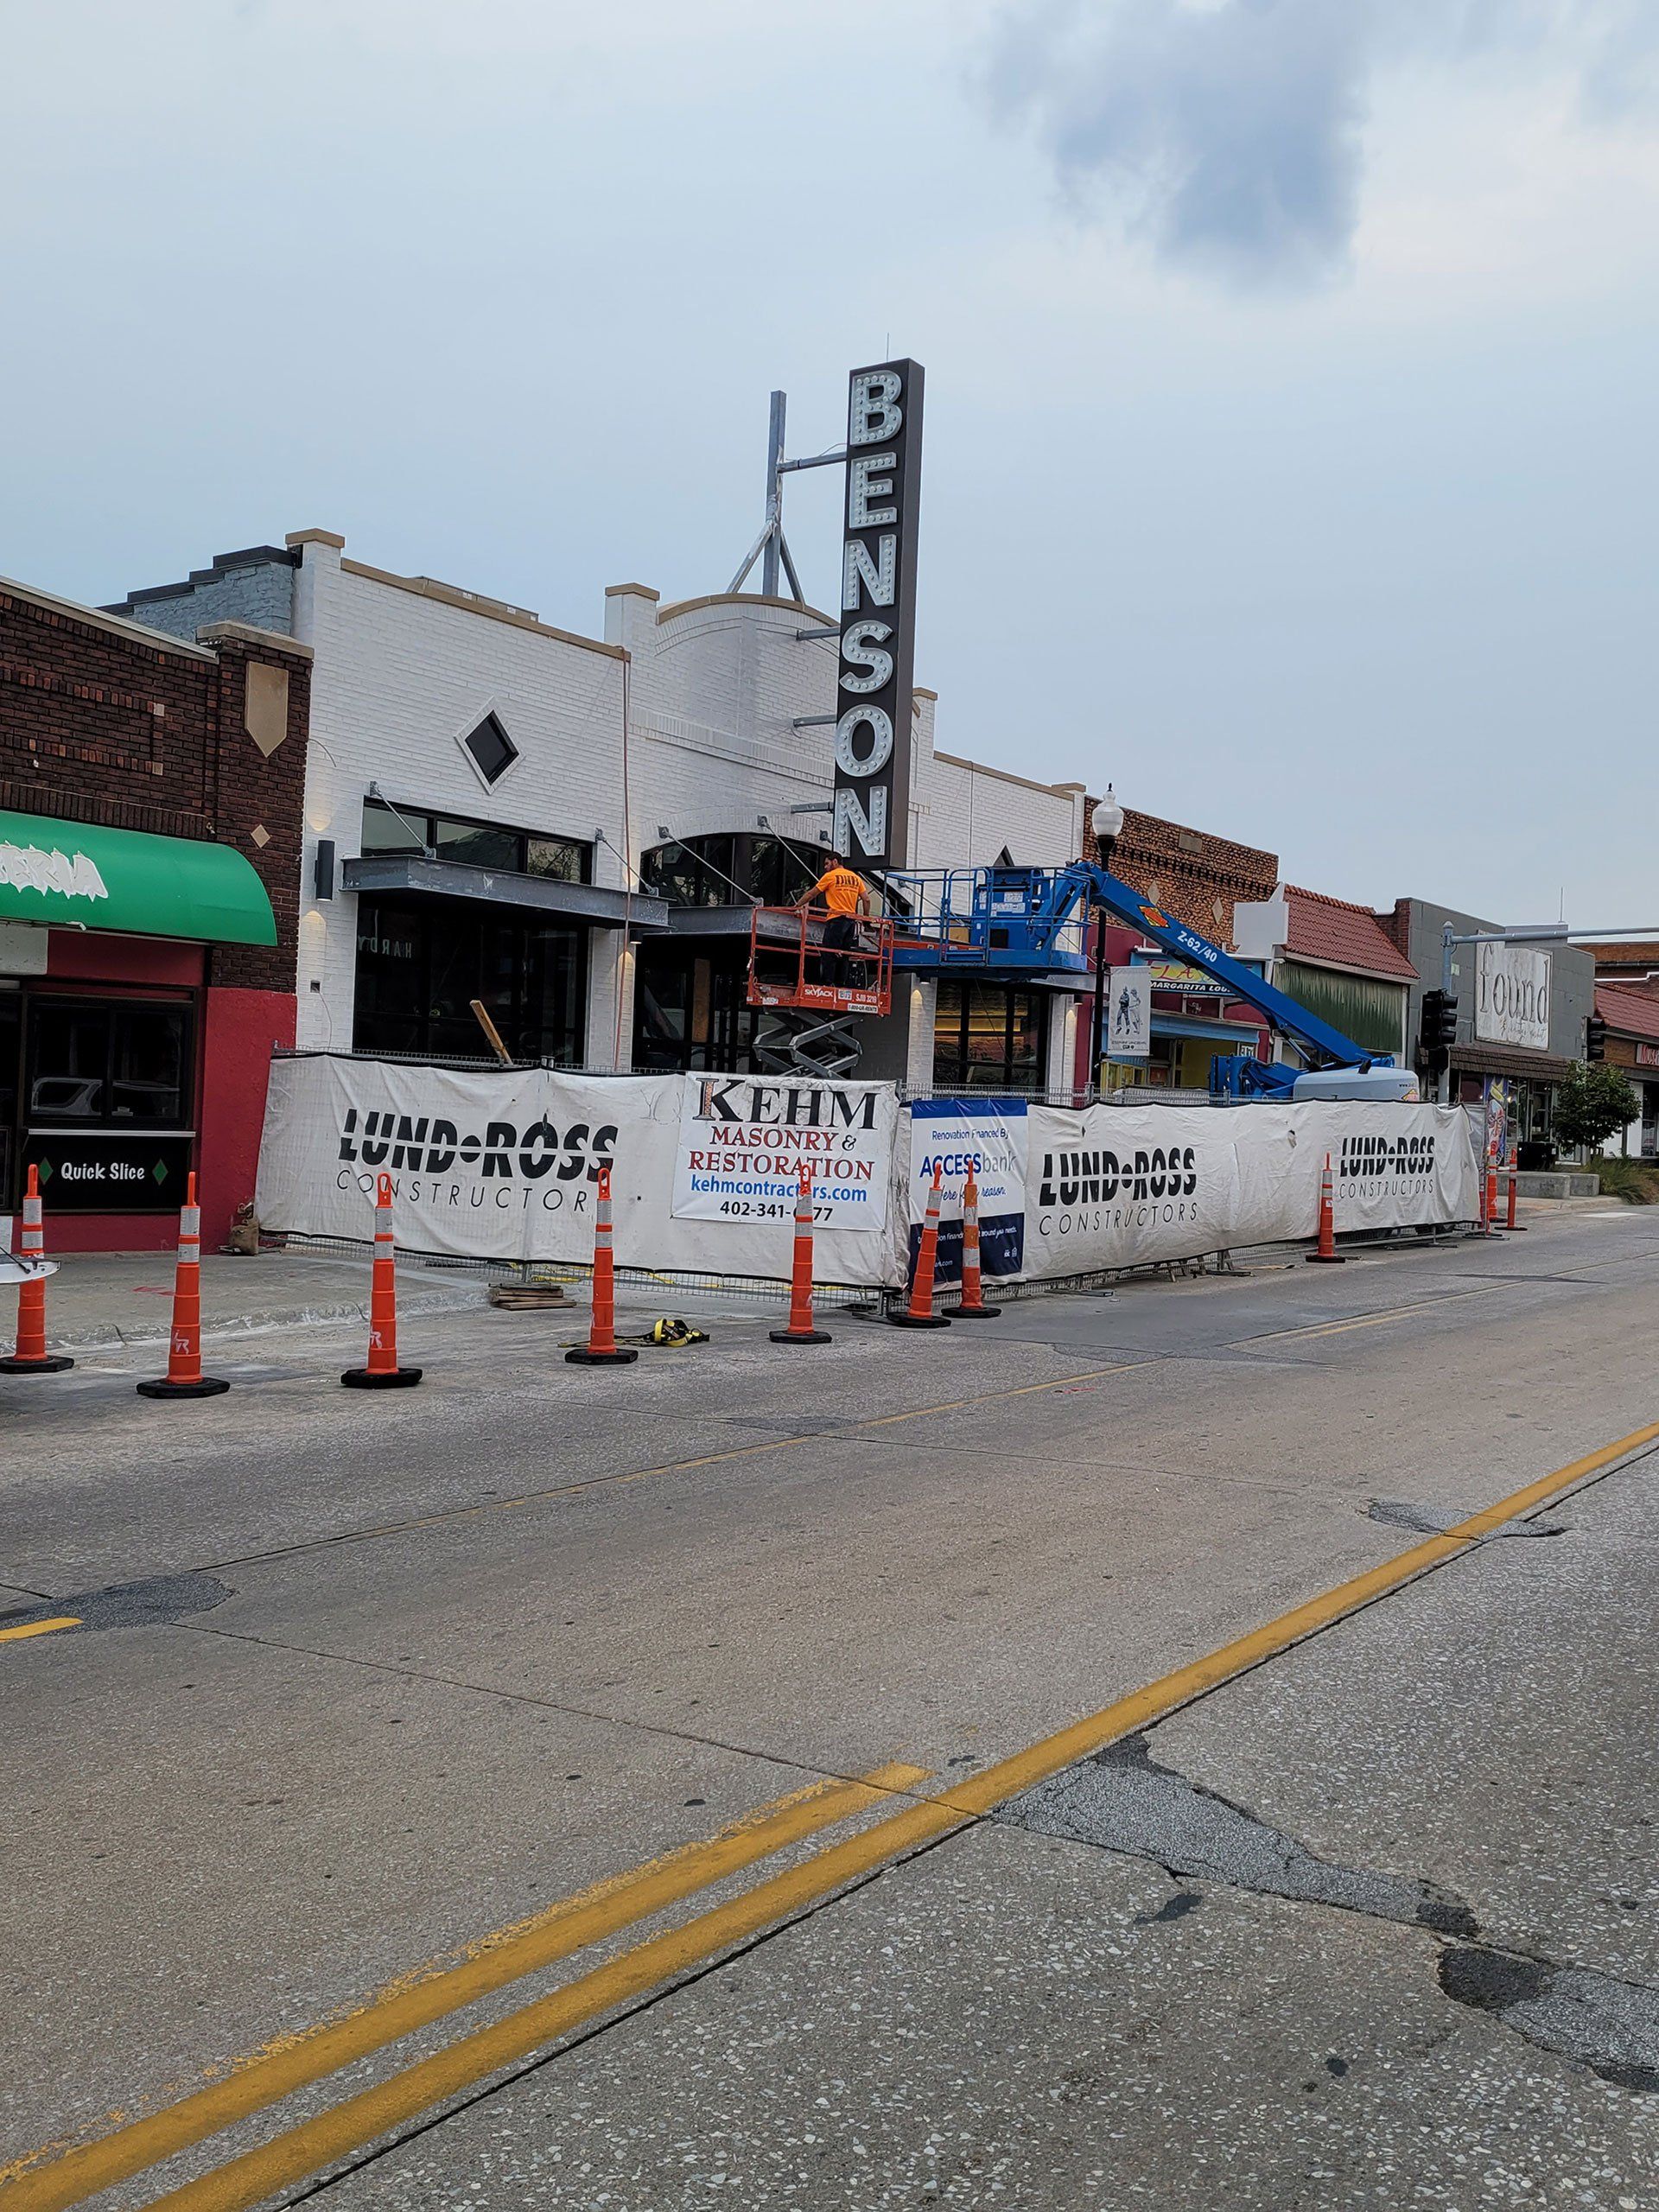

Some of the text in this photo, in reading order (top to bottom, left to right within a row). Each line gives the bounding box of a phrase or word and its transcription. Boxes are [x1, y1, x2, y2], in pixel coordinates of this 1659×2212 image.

[834, 370, 903, 858] BENSON
[1177, 931, 1217, 963] Z-62/40
[804, 986, 833, 997] SKYJACK
[1149, 980, 1206, 991] MARGARITA
[1480, 943, 1548, 1024] found
[692, 1077, 881, 1130] KEHM
[709, 1126, 857, 1151] MASONRY &
[932, 1129, 969, 1141] Renovation
[971, 1128, 1000, 1139] Fnanced
[60, 1162, 145, 1180] Quick Slice
[688, 1151, 875, 1180] RESTORATION
[336, 1169, 588, 1212] CONSTRUCTOR
[691, 1174, 867, 1202] kehmcontractrs.com
[1339, 1179, 1433, 1199] CONSTRUCTORS
[720, 1201, 833, 1222] 402-341-77
[1039, 1202, 1198, 1236] CONSTRUCTORS
